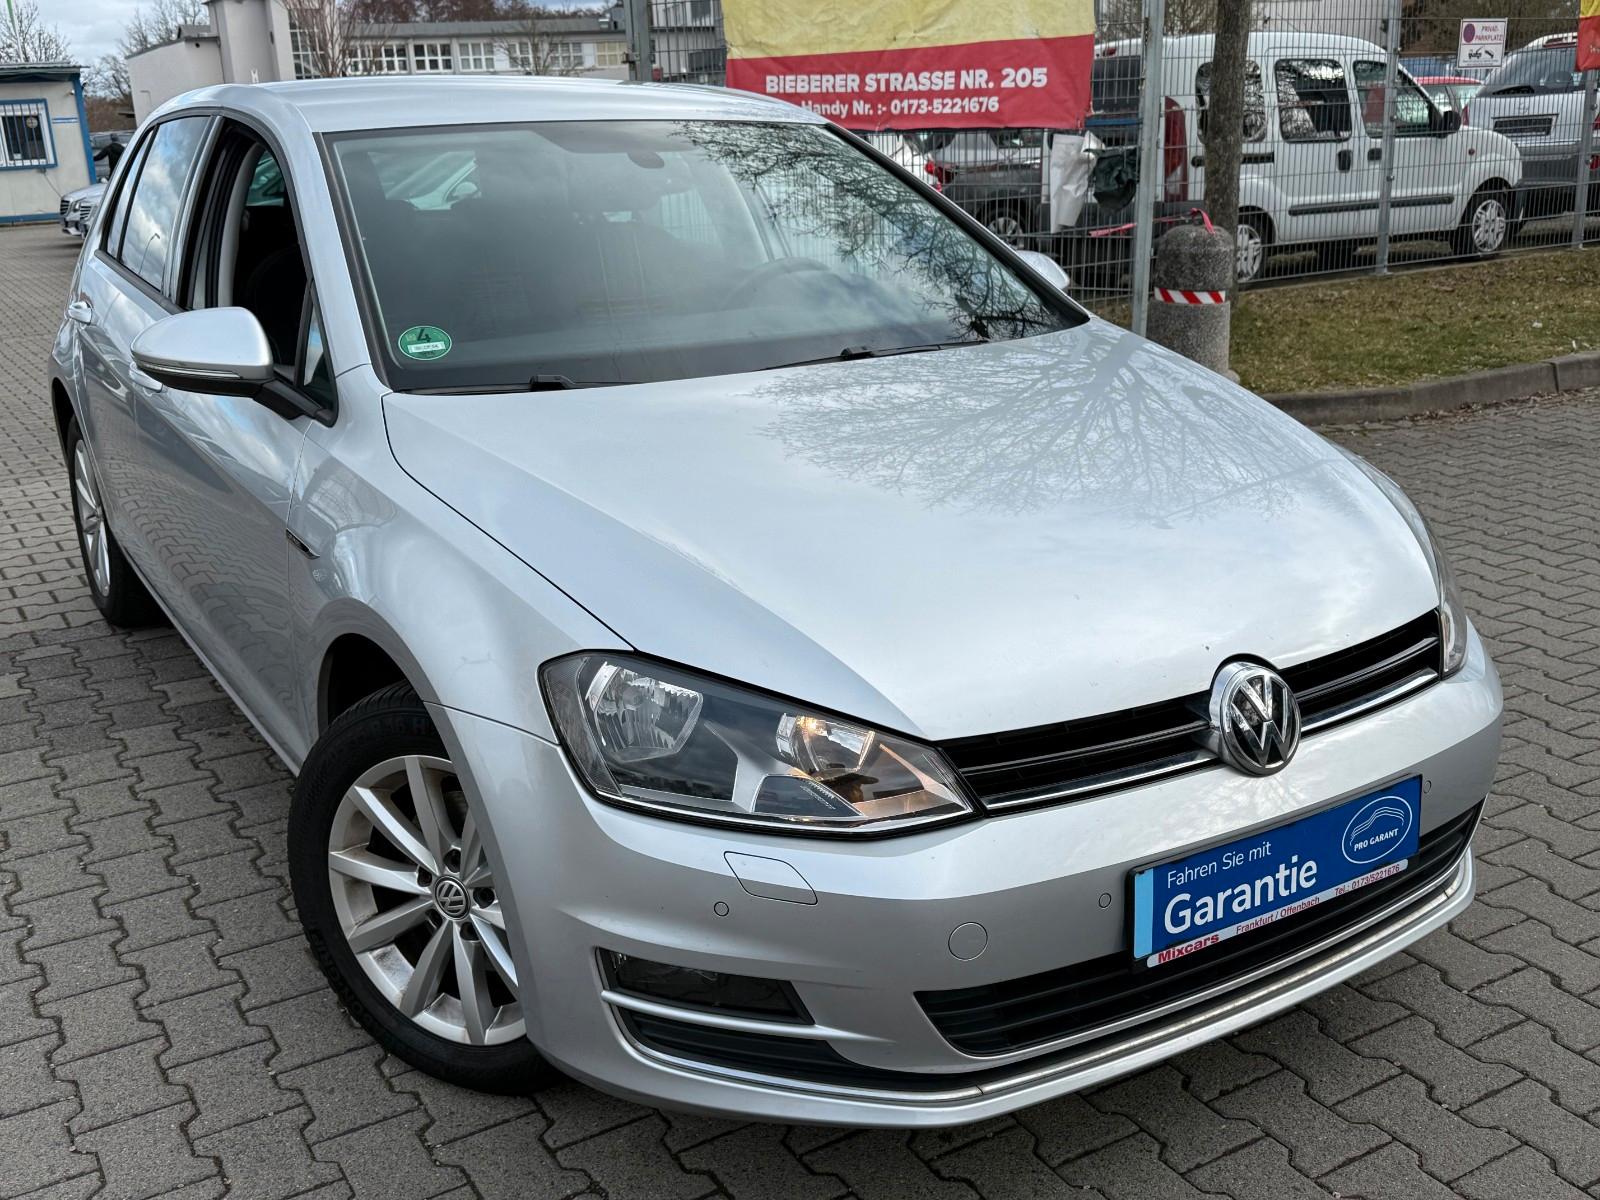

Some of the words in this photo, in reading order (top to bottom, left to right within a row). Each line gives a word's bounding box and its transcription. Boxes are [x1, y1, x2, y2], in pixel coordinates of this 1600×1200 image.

[766, 74, 860, 94] BIEBERER
[864, 71, 955, 92] STRASSE
[960, 69, 994, 90] NR.
[1000, 67, 1048, 88] 205
[852, 100, 874, 115] Nr.
[891, 97, 999, 115] 0173-5221676
[417, 329, 432, 343] 4
[1354, 842, 1367, 852] PRO
[1369, 828, 1399, 846] GARANT
[1167, 860, 1217, 888] Fahren
[1222, 852, 1244, 870] Sie
[1248, 841, 1272, 862] mit
[1164, 854, 1317, 934] Garantie
[1158, 933, 1220, 964] Mixcars
[1236, 912, 1273, 934] Frankfurt
[1280, 896, 1320, 918] Offenbach
[1351, 863, 1401, 890] 0173/5221676
